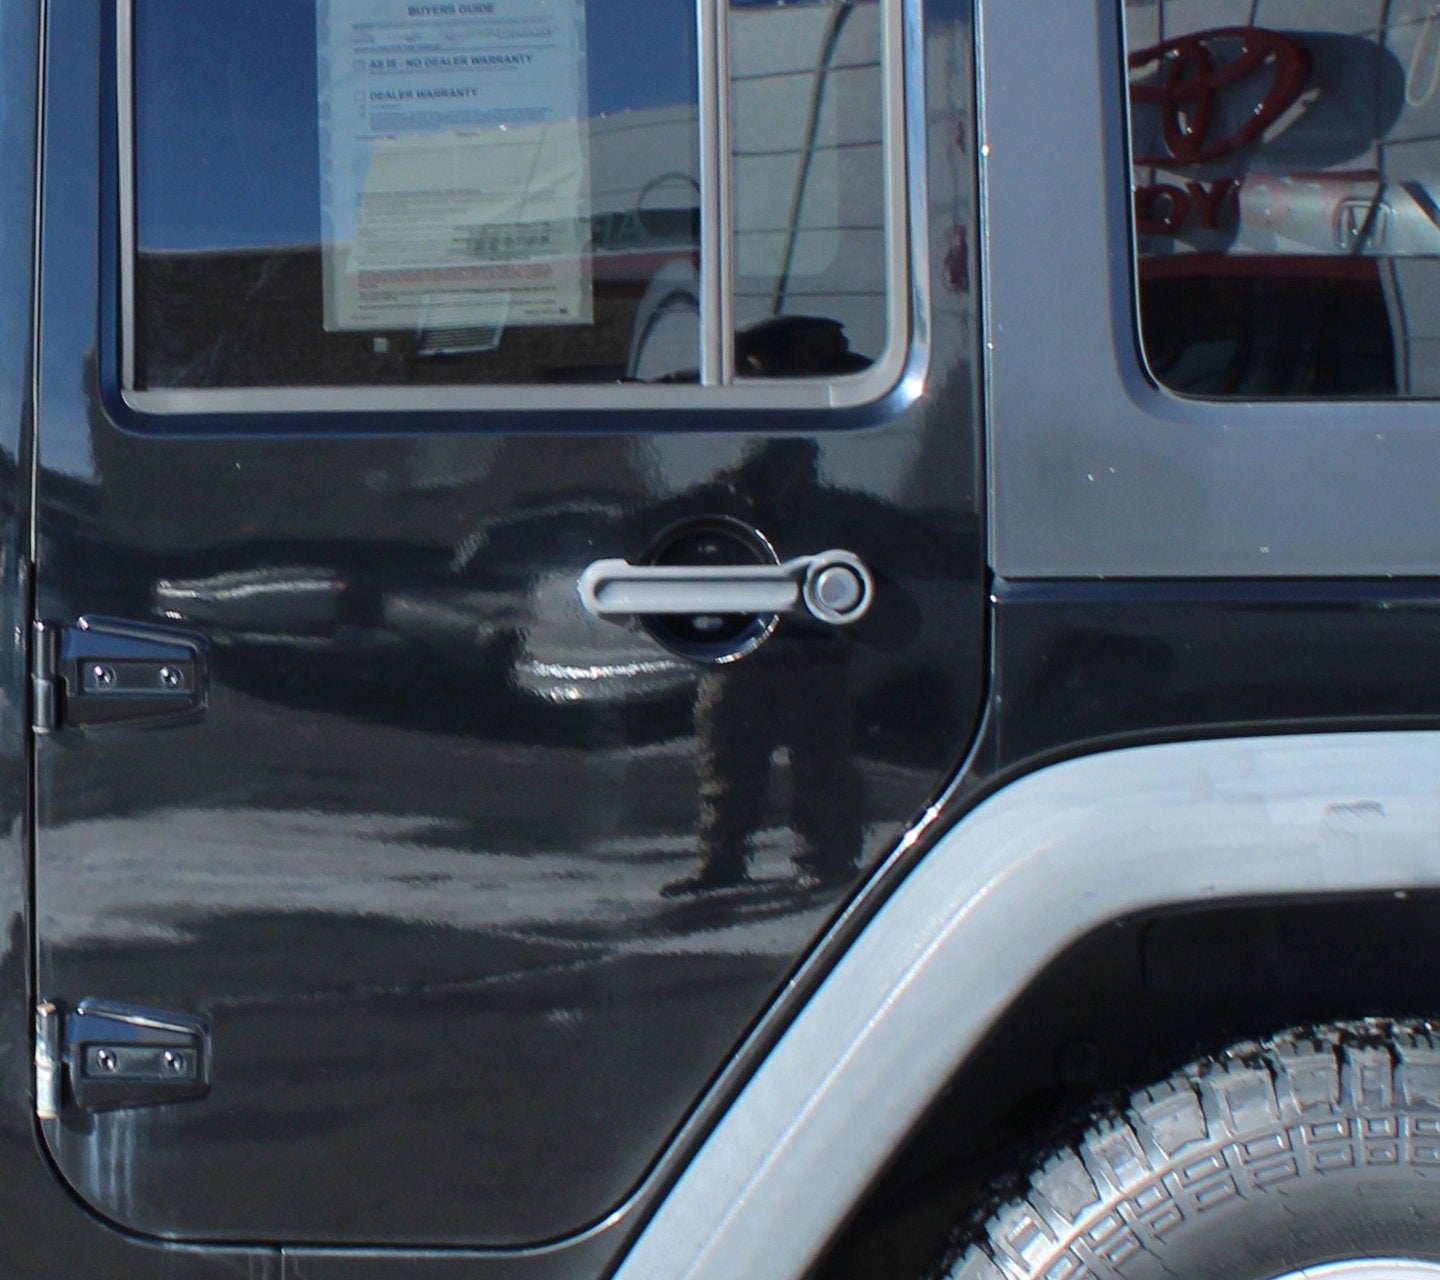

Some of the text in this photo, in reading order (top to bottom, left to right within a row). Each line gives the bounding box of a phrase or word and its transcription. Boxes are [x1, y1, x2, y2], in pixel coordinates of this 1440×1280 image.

[408, 2, 496, 16] BUYERS GUIDE
[470, 53, 534, 66] WARRANTY
[416, 87, 479, 99] WARRANTY
